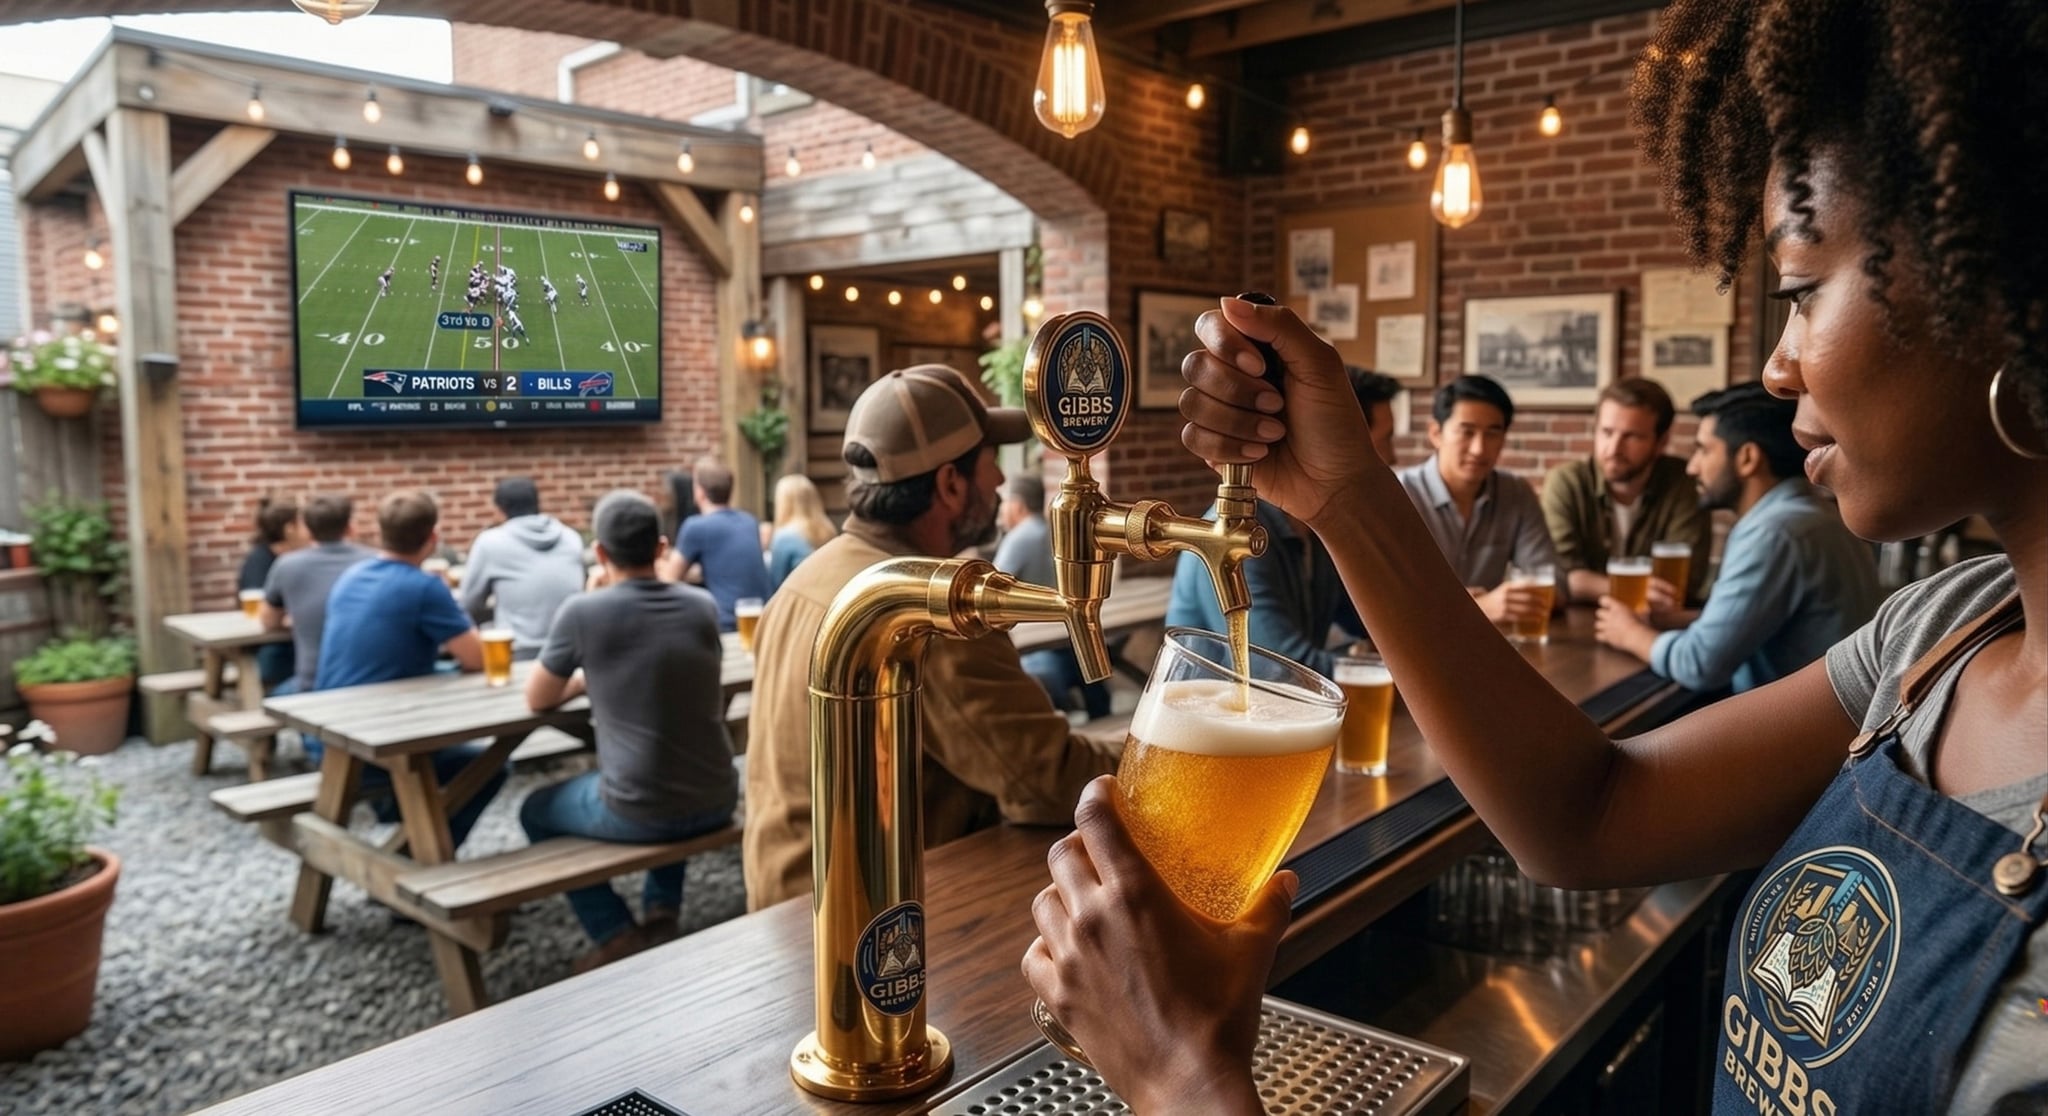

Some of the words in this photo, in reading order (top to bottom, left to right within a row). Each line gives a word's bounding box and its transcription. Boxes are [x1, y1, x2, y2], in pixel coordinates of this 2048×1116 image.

[411, 376, 475, 390] PATRIOTS
[483, 378, 497, 389] VS
[506, 376, 517, 391] 2
[537, 377, 572, 390] BILLS
[1058, 396, 1114, 416] GIBBS
[1062, 415, 1110, 428] BREWERY
[870, 968, 926, 999] GIBBS
[1724, 1045, 1785, 1116] BREW
